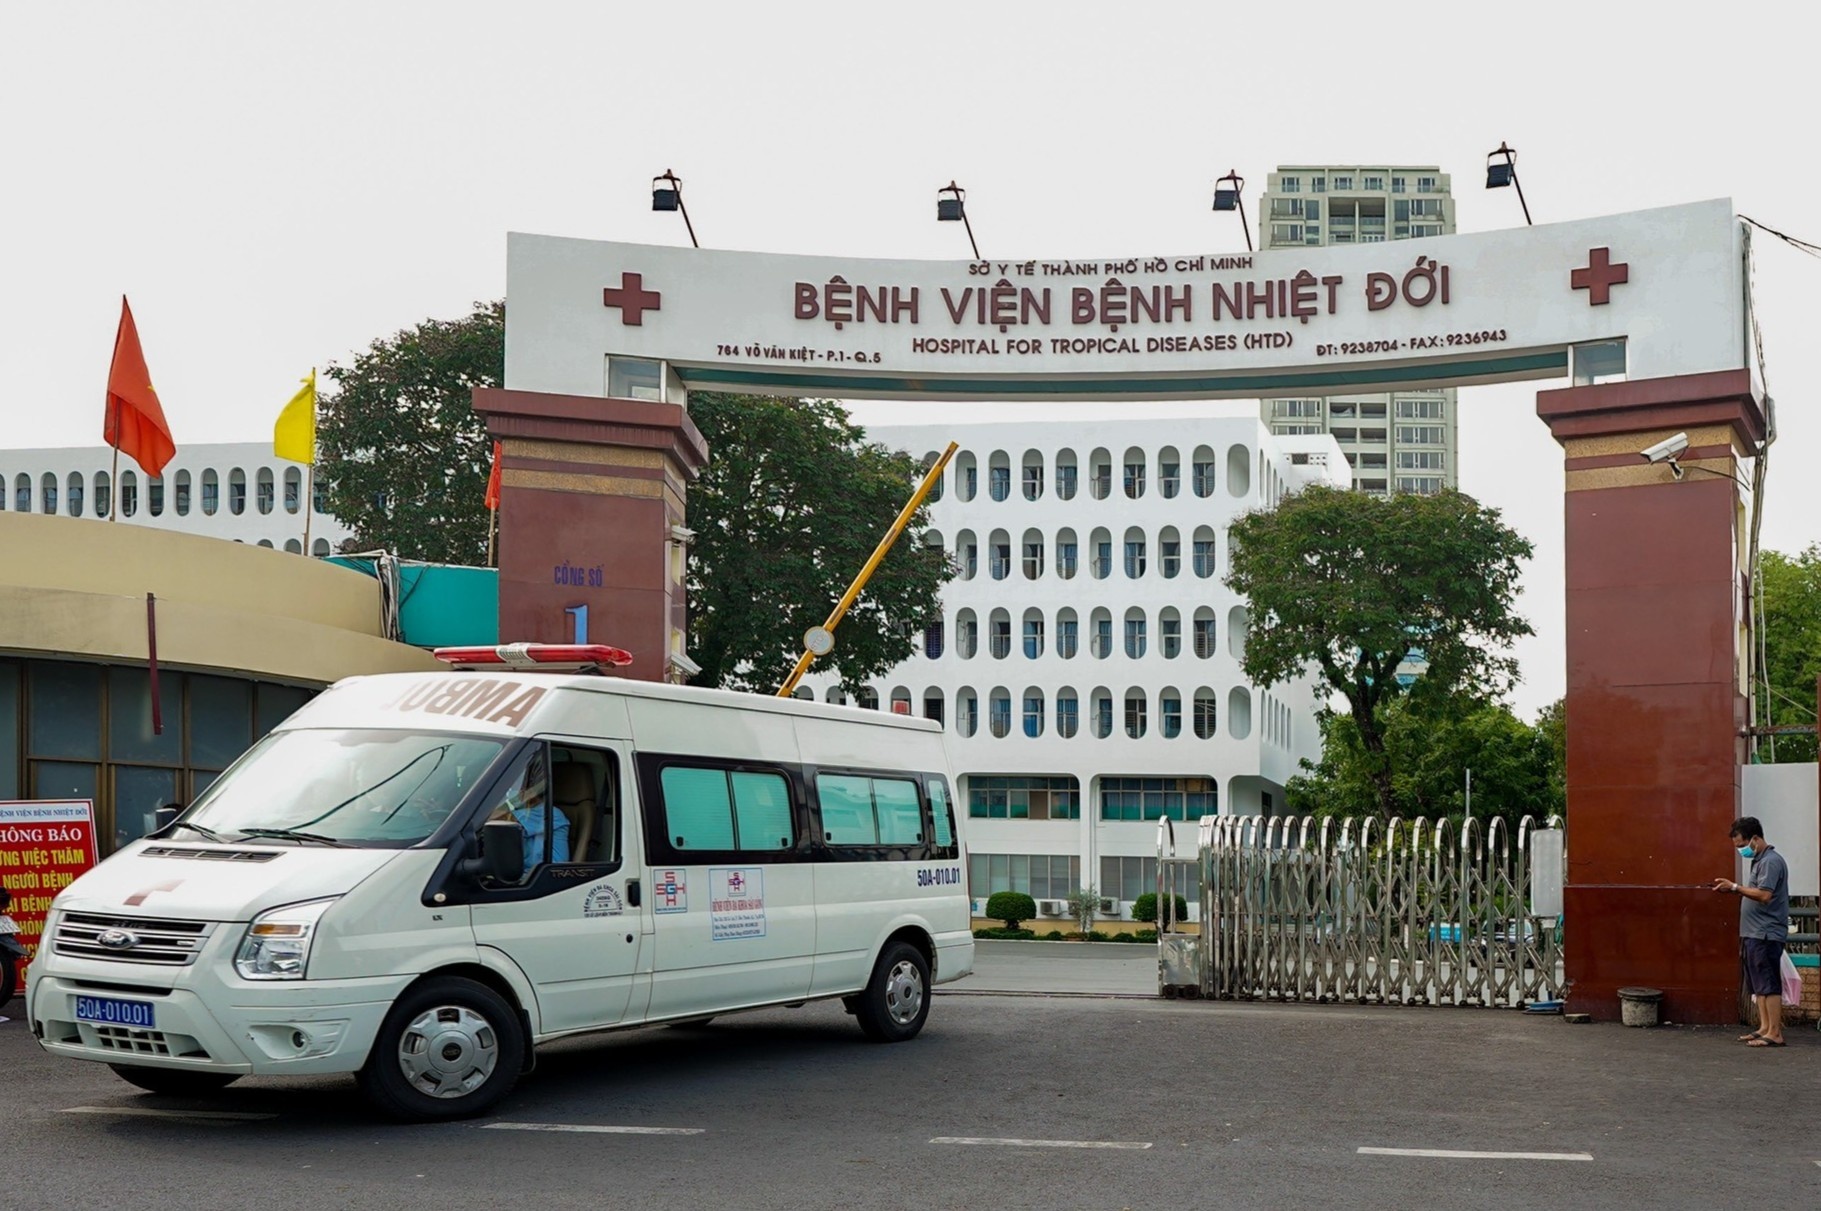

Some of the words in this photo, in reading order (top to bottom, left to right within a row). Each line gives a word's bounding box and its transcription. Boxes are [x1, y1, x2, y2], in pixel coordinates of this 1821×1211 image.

[969, 259, 991, 276] SỞ
[997, 263, 1009, 276] Y
[1015, 259, 1037, 276] TẾ
[1041, 259, 1098, 276] THÀNH
[1104, 257, 1139, 275] PHỐ
[1144, 256, 1168, 273] HỒ
[1174, 255, 1204, 272] CHÍ
[1210, 256, 1253, 271] MINH
[794, 275, 919, 330] BỆNH
[940, 278, 1051, 333] VIỆN
[1071, 278, 1192, 332] BỆNH
[1212, 269, 1343, 324] NHIỆT
[1365, 255, 1449, 312] ĐỚI
[912, 336, 999, 355] HOSPITAL
[1006, 338, 1042, 354] FOR
[1050, 337, 1140, 354] TROPICAL
[1146, 334, 1237, 353] DISEASES
[1243, 331, 1293, 350] (HTD)
[1340, 339, 1398, 354] 9238704
[1446, 329, 1507, 346] 9236943
[717, 345, 739, 356] 764
[745, 342, 761, 357] VÕ
[763, 344, 786, 360] VĂN
[789, 346, 816, 363] KIỆT
[564, 604, 589, 645] 1
[0, 808, 14, 818] ỆNH
[0, 826, 43, 843] HÔNG
[47, 824, 82, 842] BÁO
[0, 850, 20, 866] NG
[21, 847, 49, 869] VIỆC
[50, 846, 85, 865] THĂM
[2, 870, 40, 889] NGƯỜI
[42, 870, 74, 891] BỆNH
[917, 867, 960, 887] 50A-010.01
[21, 894, 52, 915] BỆNH
[78, 997, 149, 1025] 50A-010.01
